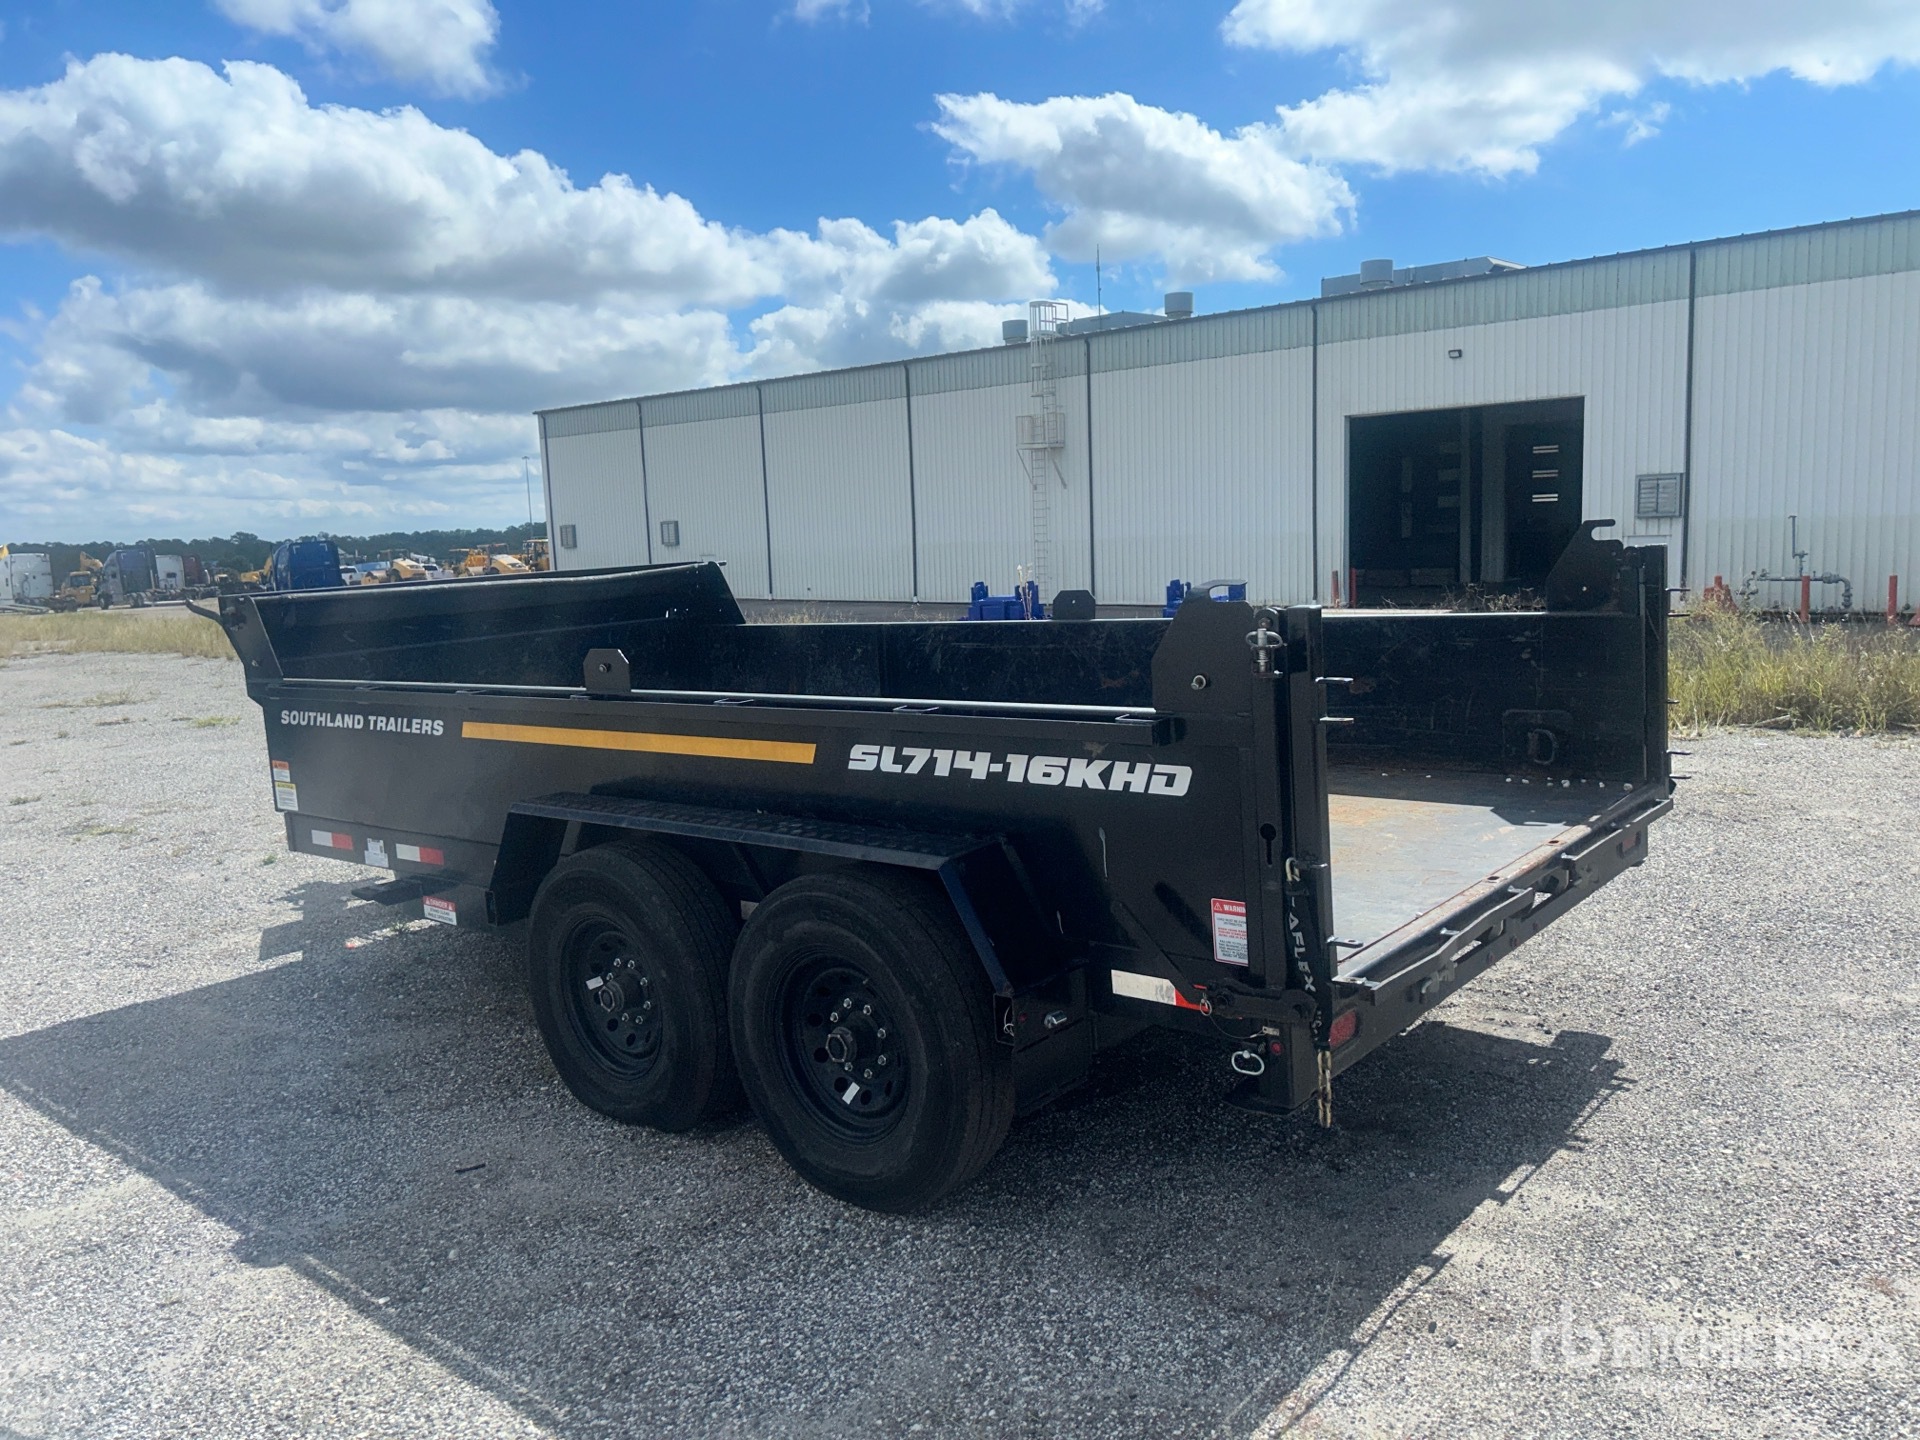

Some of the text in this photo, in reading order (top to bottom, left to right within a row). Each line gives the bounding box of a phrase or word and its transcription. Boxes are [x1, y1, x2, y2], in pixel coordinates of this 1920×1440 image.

[281, 709, 444, 736] SOUTHLAND TRAILERS
[847, 743, 1193, 797] SL714-16KHD
